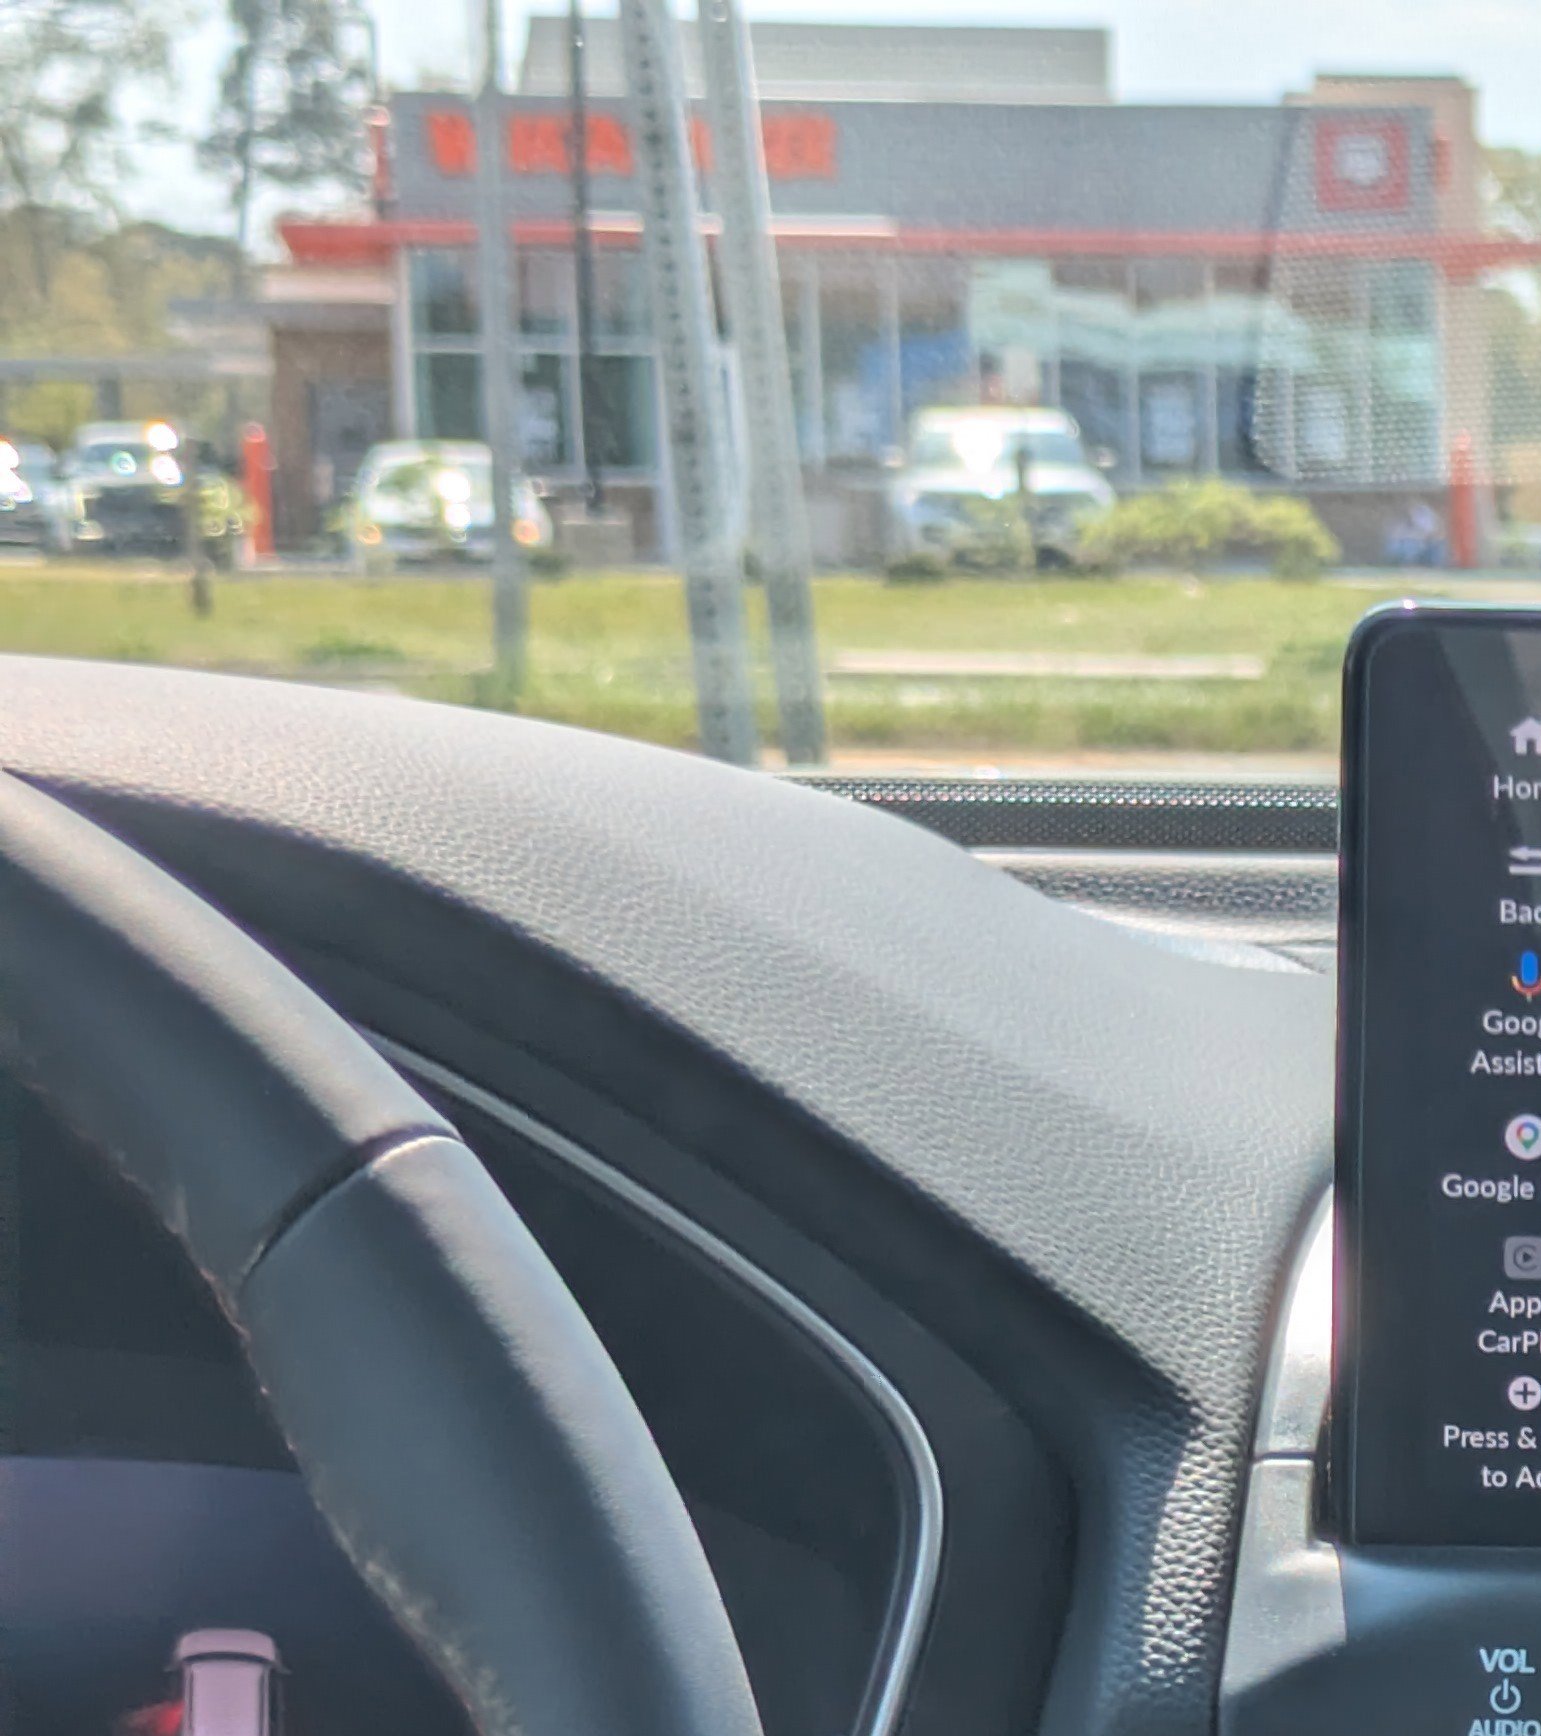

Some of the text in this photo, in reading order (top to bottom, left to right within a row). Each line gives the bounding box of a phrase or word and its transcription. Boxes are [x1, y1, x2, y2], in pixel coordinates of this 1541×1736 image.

[1442, 1174, 1534, 1202] Google
[1443, 1426, 1509, 1450] Press
[1517, 1428, 1537, 1450] &
[1482, 1467, 1507, 1489] to
[1479, 1648, 1535, 1673] VOL
